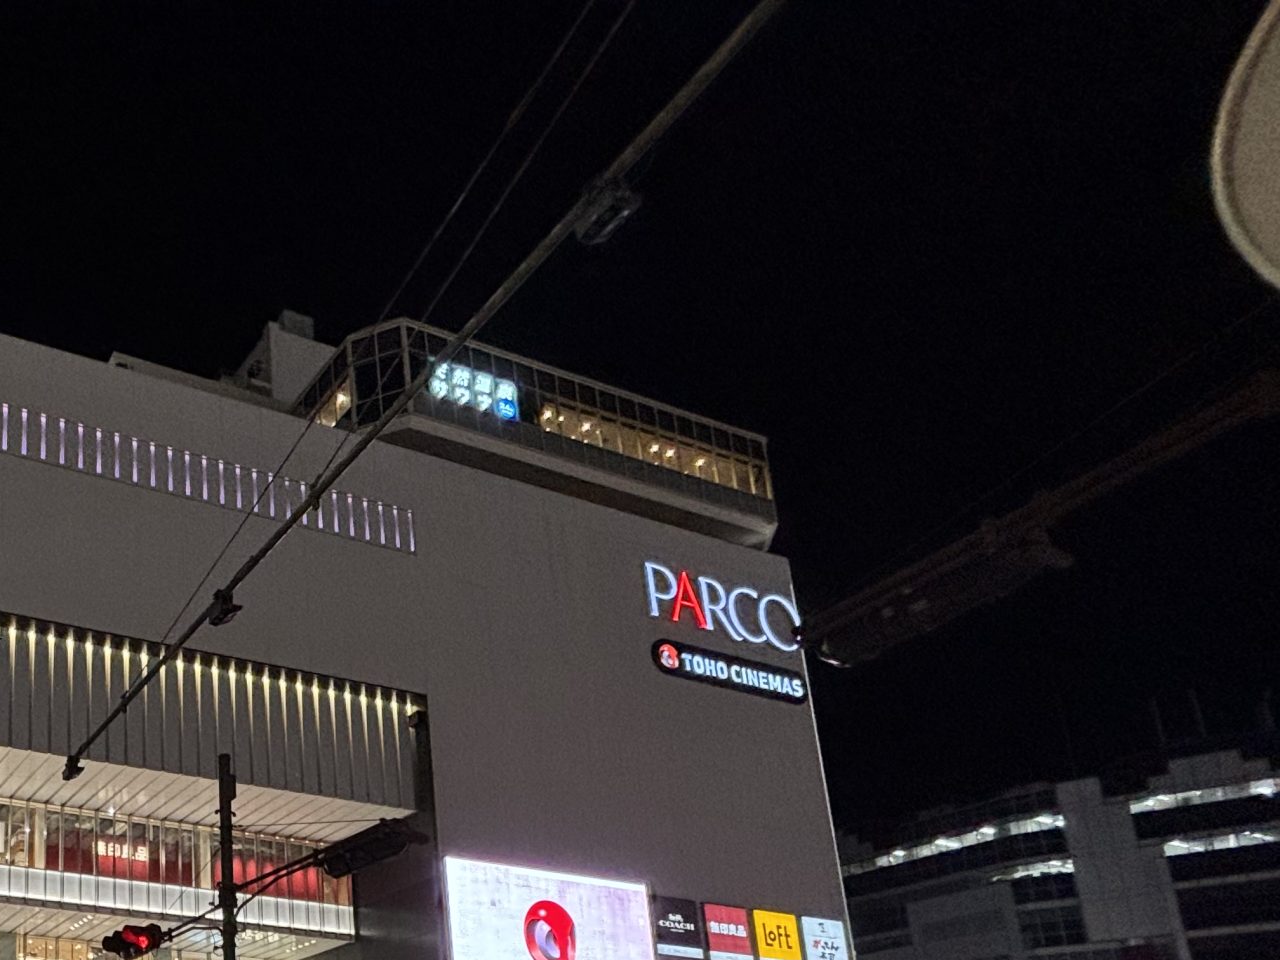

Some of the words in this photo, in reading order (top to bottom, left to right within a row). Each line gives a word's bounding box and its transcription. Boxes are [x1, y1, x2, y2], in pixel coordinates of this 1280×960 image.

[644, 561, 802, 652] PARCO
[680, 651, 729, 680] TOHO
[730, 664, 804, 698] CINEMAS
[658, 919, 695, 931] COACH
[709, 920, 747, 938] 無印良品
